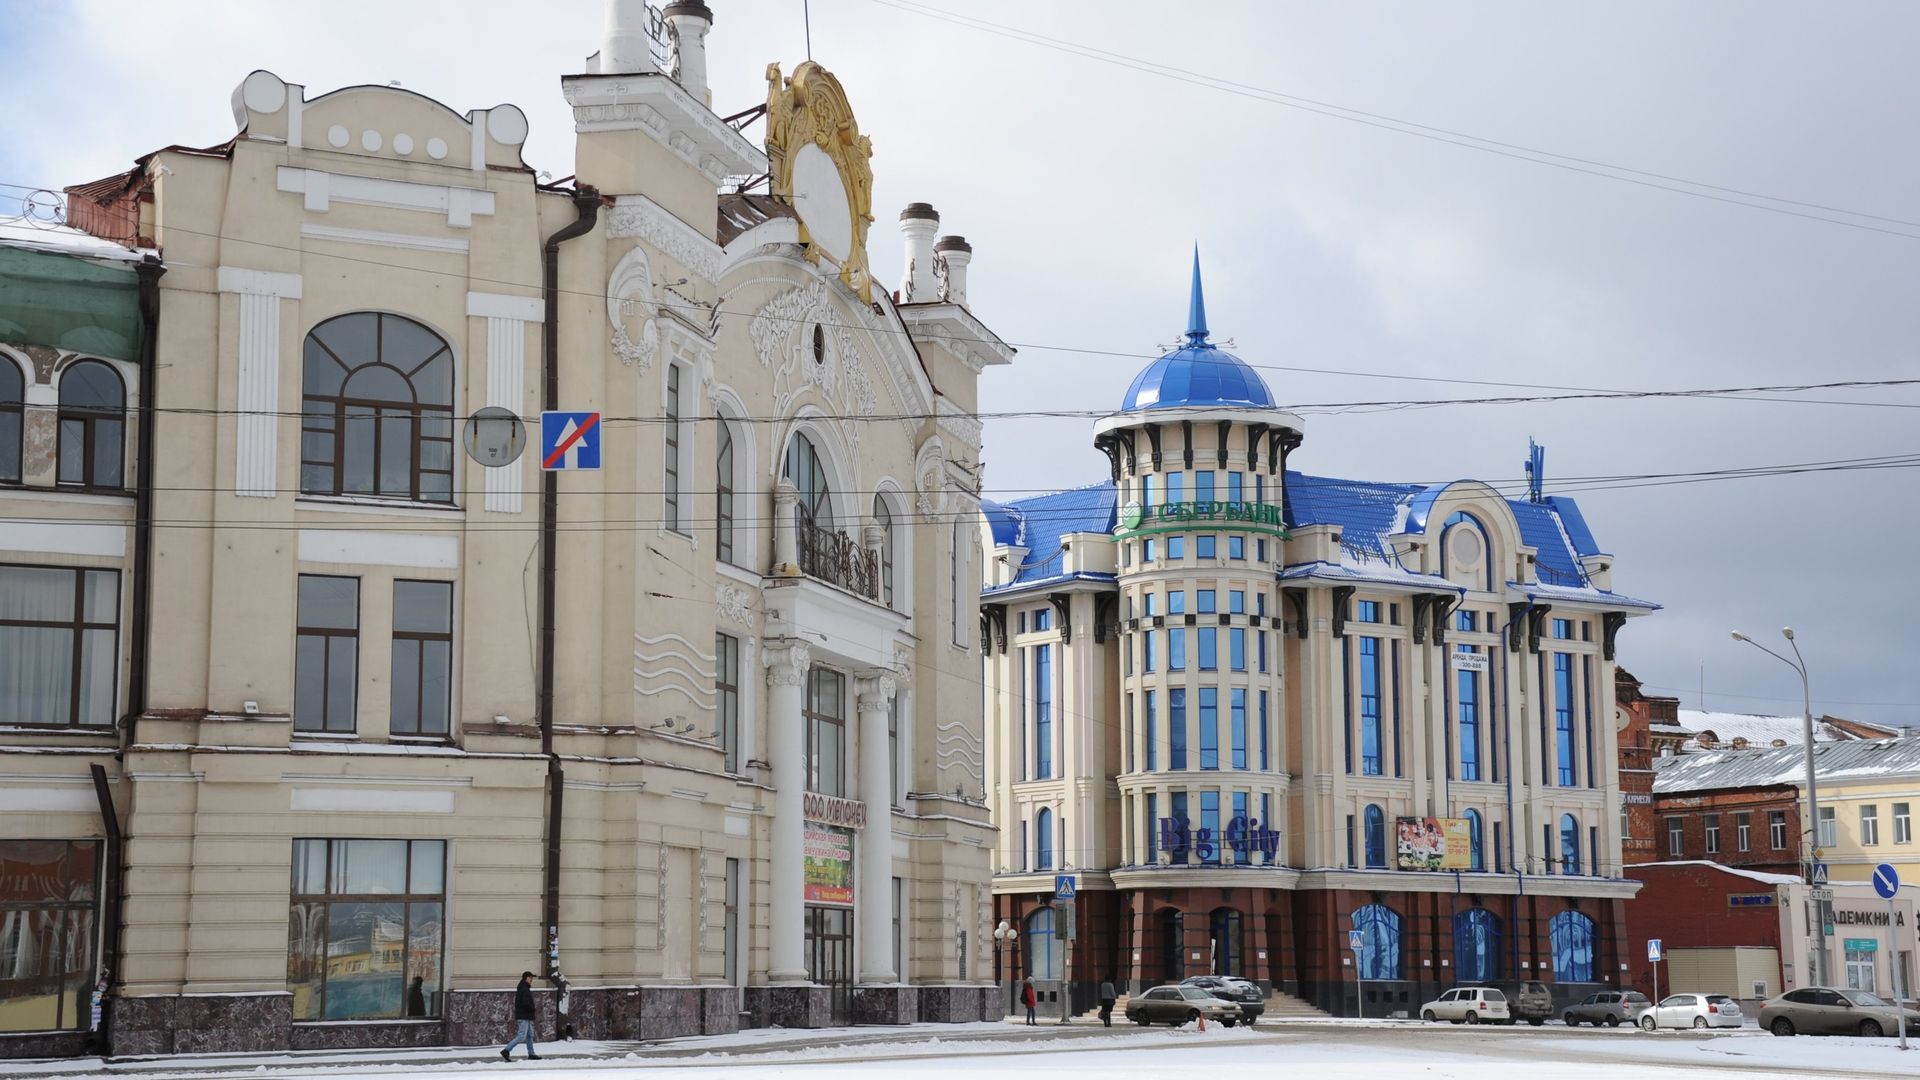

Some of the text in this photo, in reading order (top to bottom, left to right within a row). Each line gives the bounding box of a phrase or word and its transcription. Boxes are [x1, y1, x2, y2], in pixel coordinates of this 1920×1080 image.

[1158, 501, 1281, 525] СБЕРБАНК
[1158, 816, 1281, 860] Big City
[1811, 891, 1832, 899] СТОП
